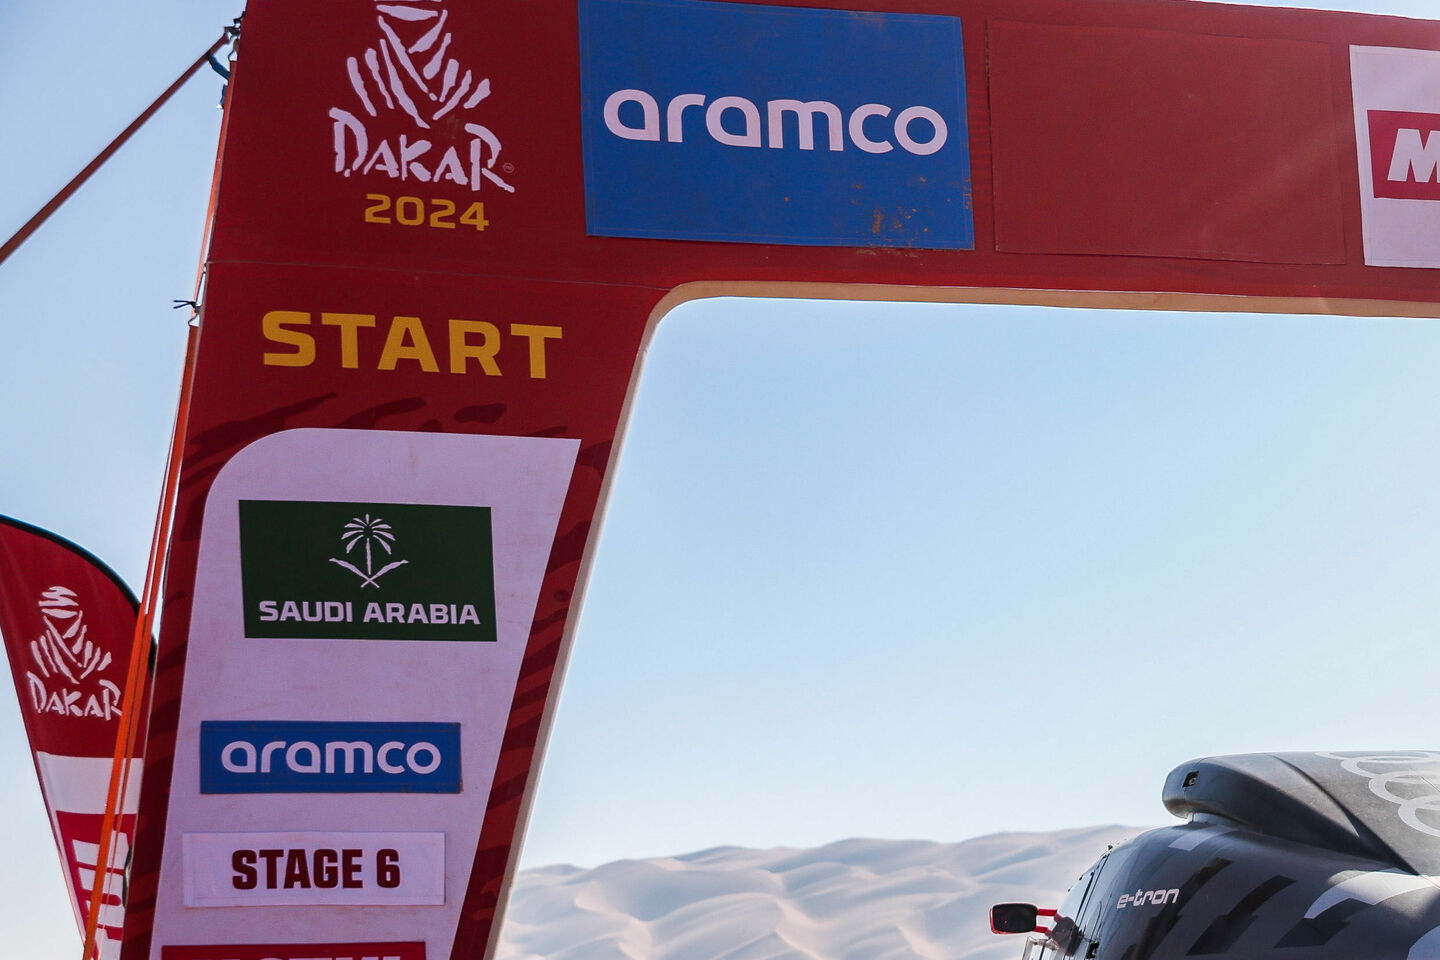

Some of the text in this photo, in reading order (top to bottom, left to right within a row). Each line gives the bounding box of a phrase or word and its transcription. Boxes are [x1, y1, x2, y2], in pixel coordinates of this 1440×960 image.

[603, 89, 948, 156] aramco
[329, 107, 515, 192] DAKAR
[364, 193, 489, 231] 2024
[262, 310, 562, 379] START
[259, 600, 480, 625] SAUDI ARABIA
[26, 671, 122, 721] DAKAR
[221, 741, 441, 774] aramco
[232, 848, 400, 889] STAGE 6
[1117, 889, 1180, 909] e-tron
